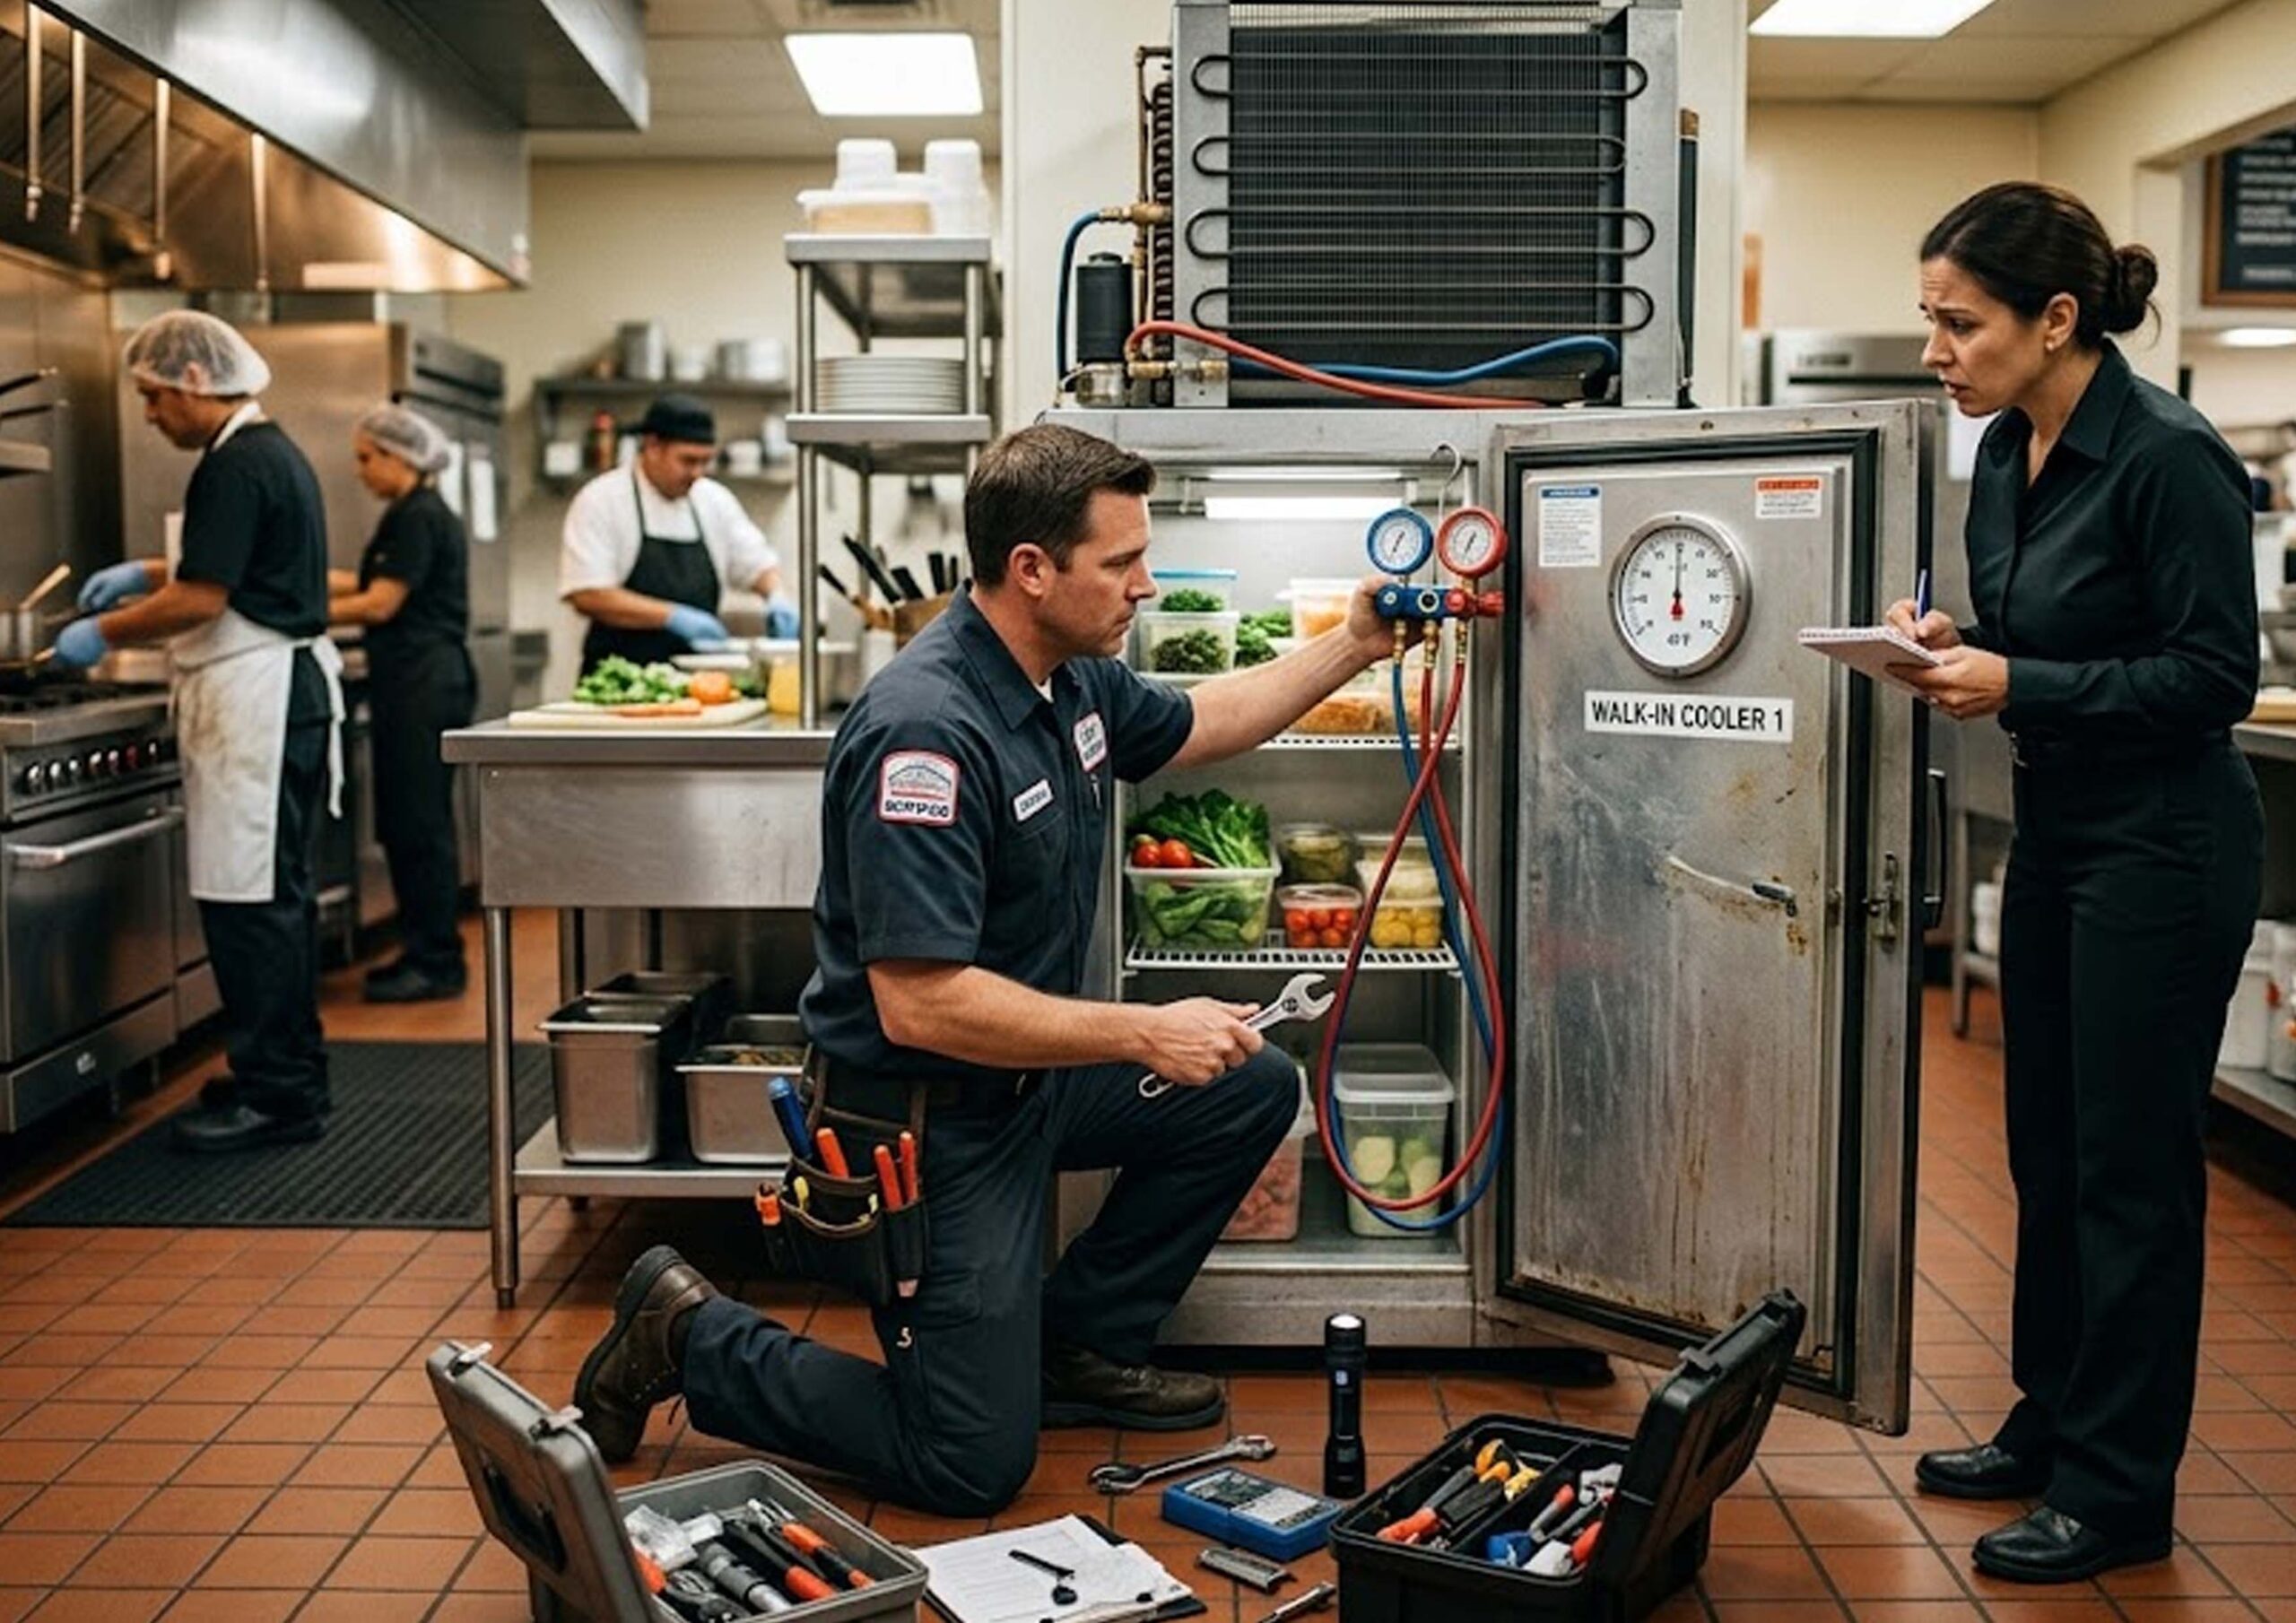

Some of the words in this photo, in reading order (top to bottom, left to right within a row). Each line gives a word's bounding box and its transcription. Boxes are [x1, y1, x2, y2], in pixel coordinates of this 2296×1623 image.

[1591, 699, 1674, 727] WALK-IN
[1681, 703, 1766, 732] COOLER
[1775, 707, 1784, 732] 1
